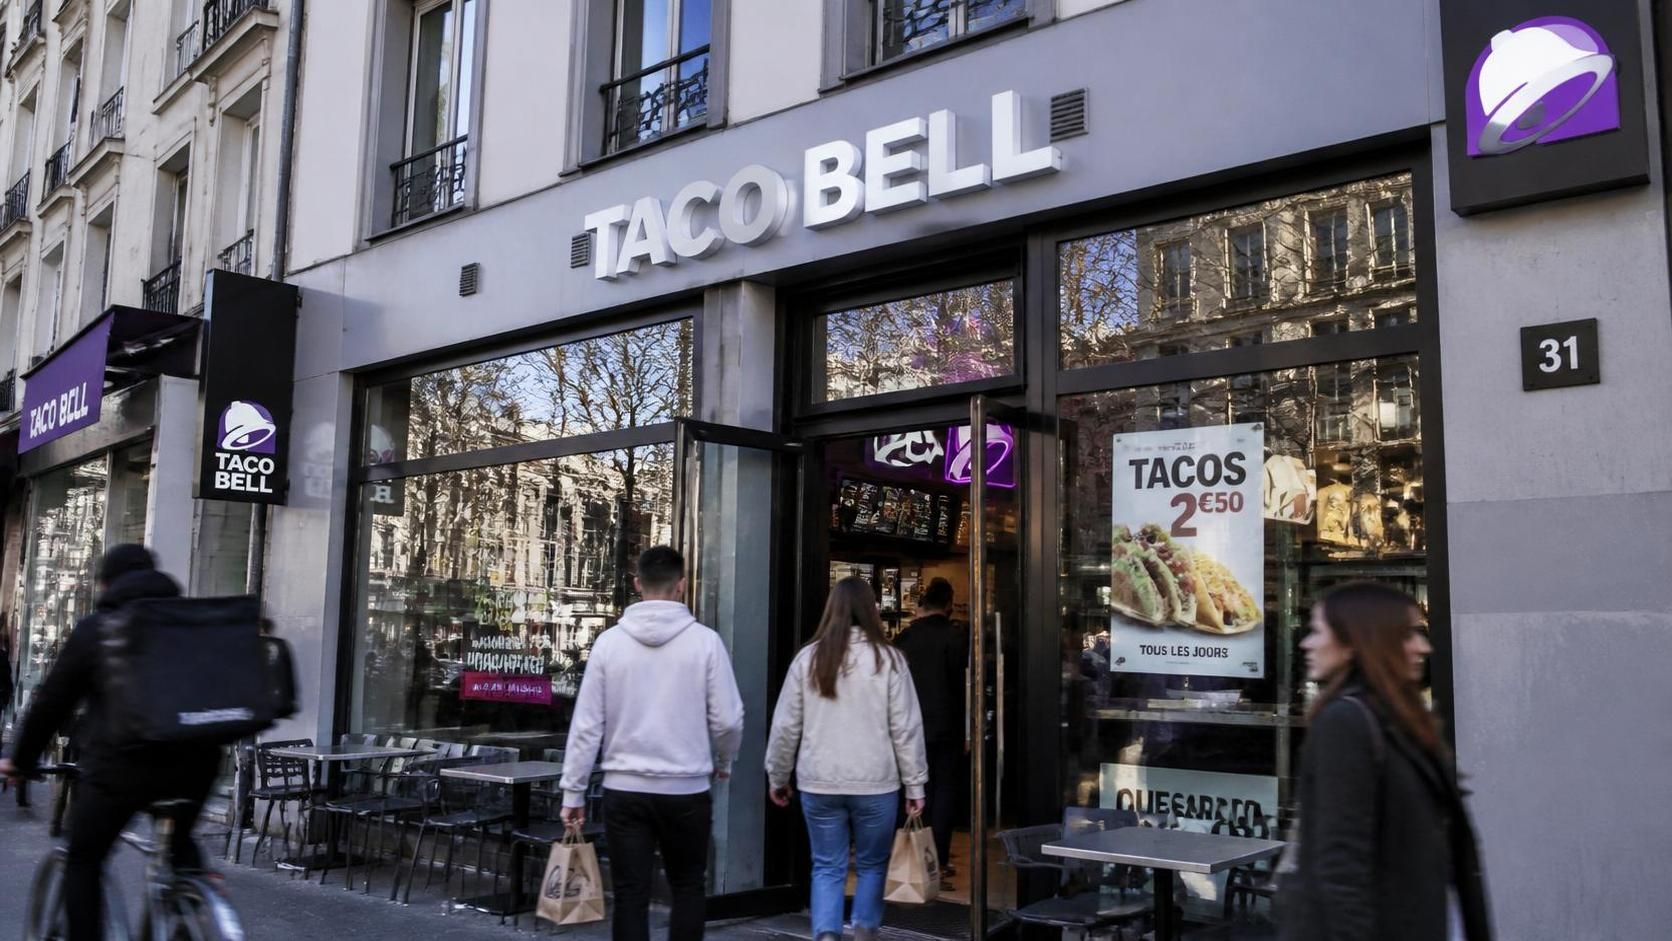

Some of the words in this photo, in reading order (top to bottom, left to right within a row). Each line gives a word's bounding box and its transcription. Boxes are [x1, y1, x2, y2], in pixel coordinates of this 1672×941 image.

[584, 164, 790, 281] TACO
[803, 90, 1062, 231] BELL
[1539, 335, 1578, 373] 31
[214, 471, 273, 494] BELL
[215, 452, 275, 475] TACO
[1128, 451, 1247, 490] TACOS
[1170, 491, 1244, 538] 2€50
[1139, 644, 1168, 656] TOUS
[1170, 646, 1190, 657] LES
